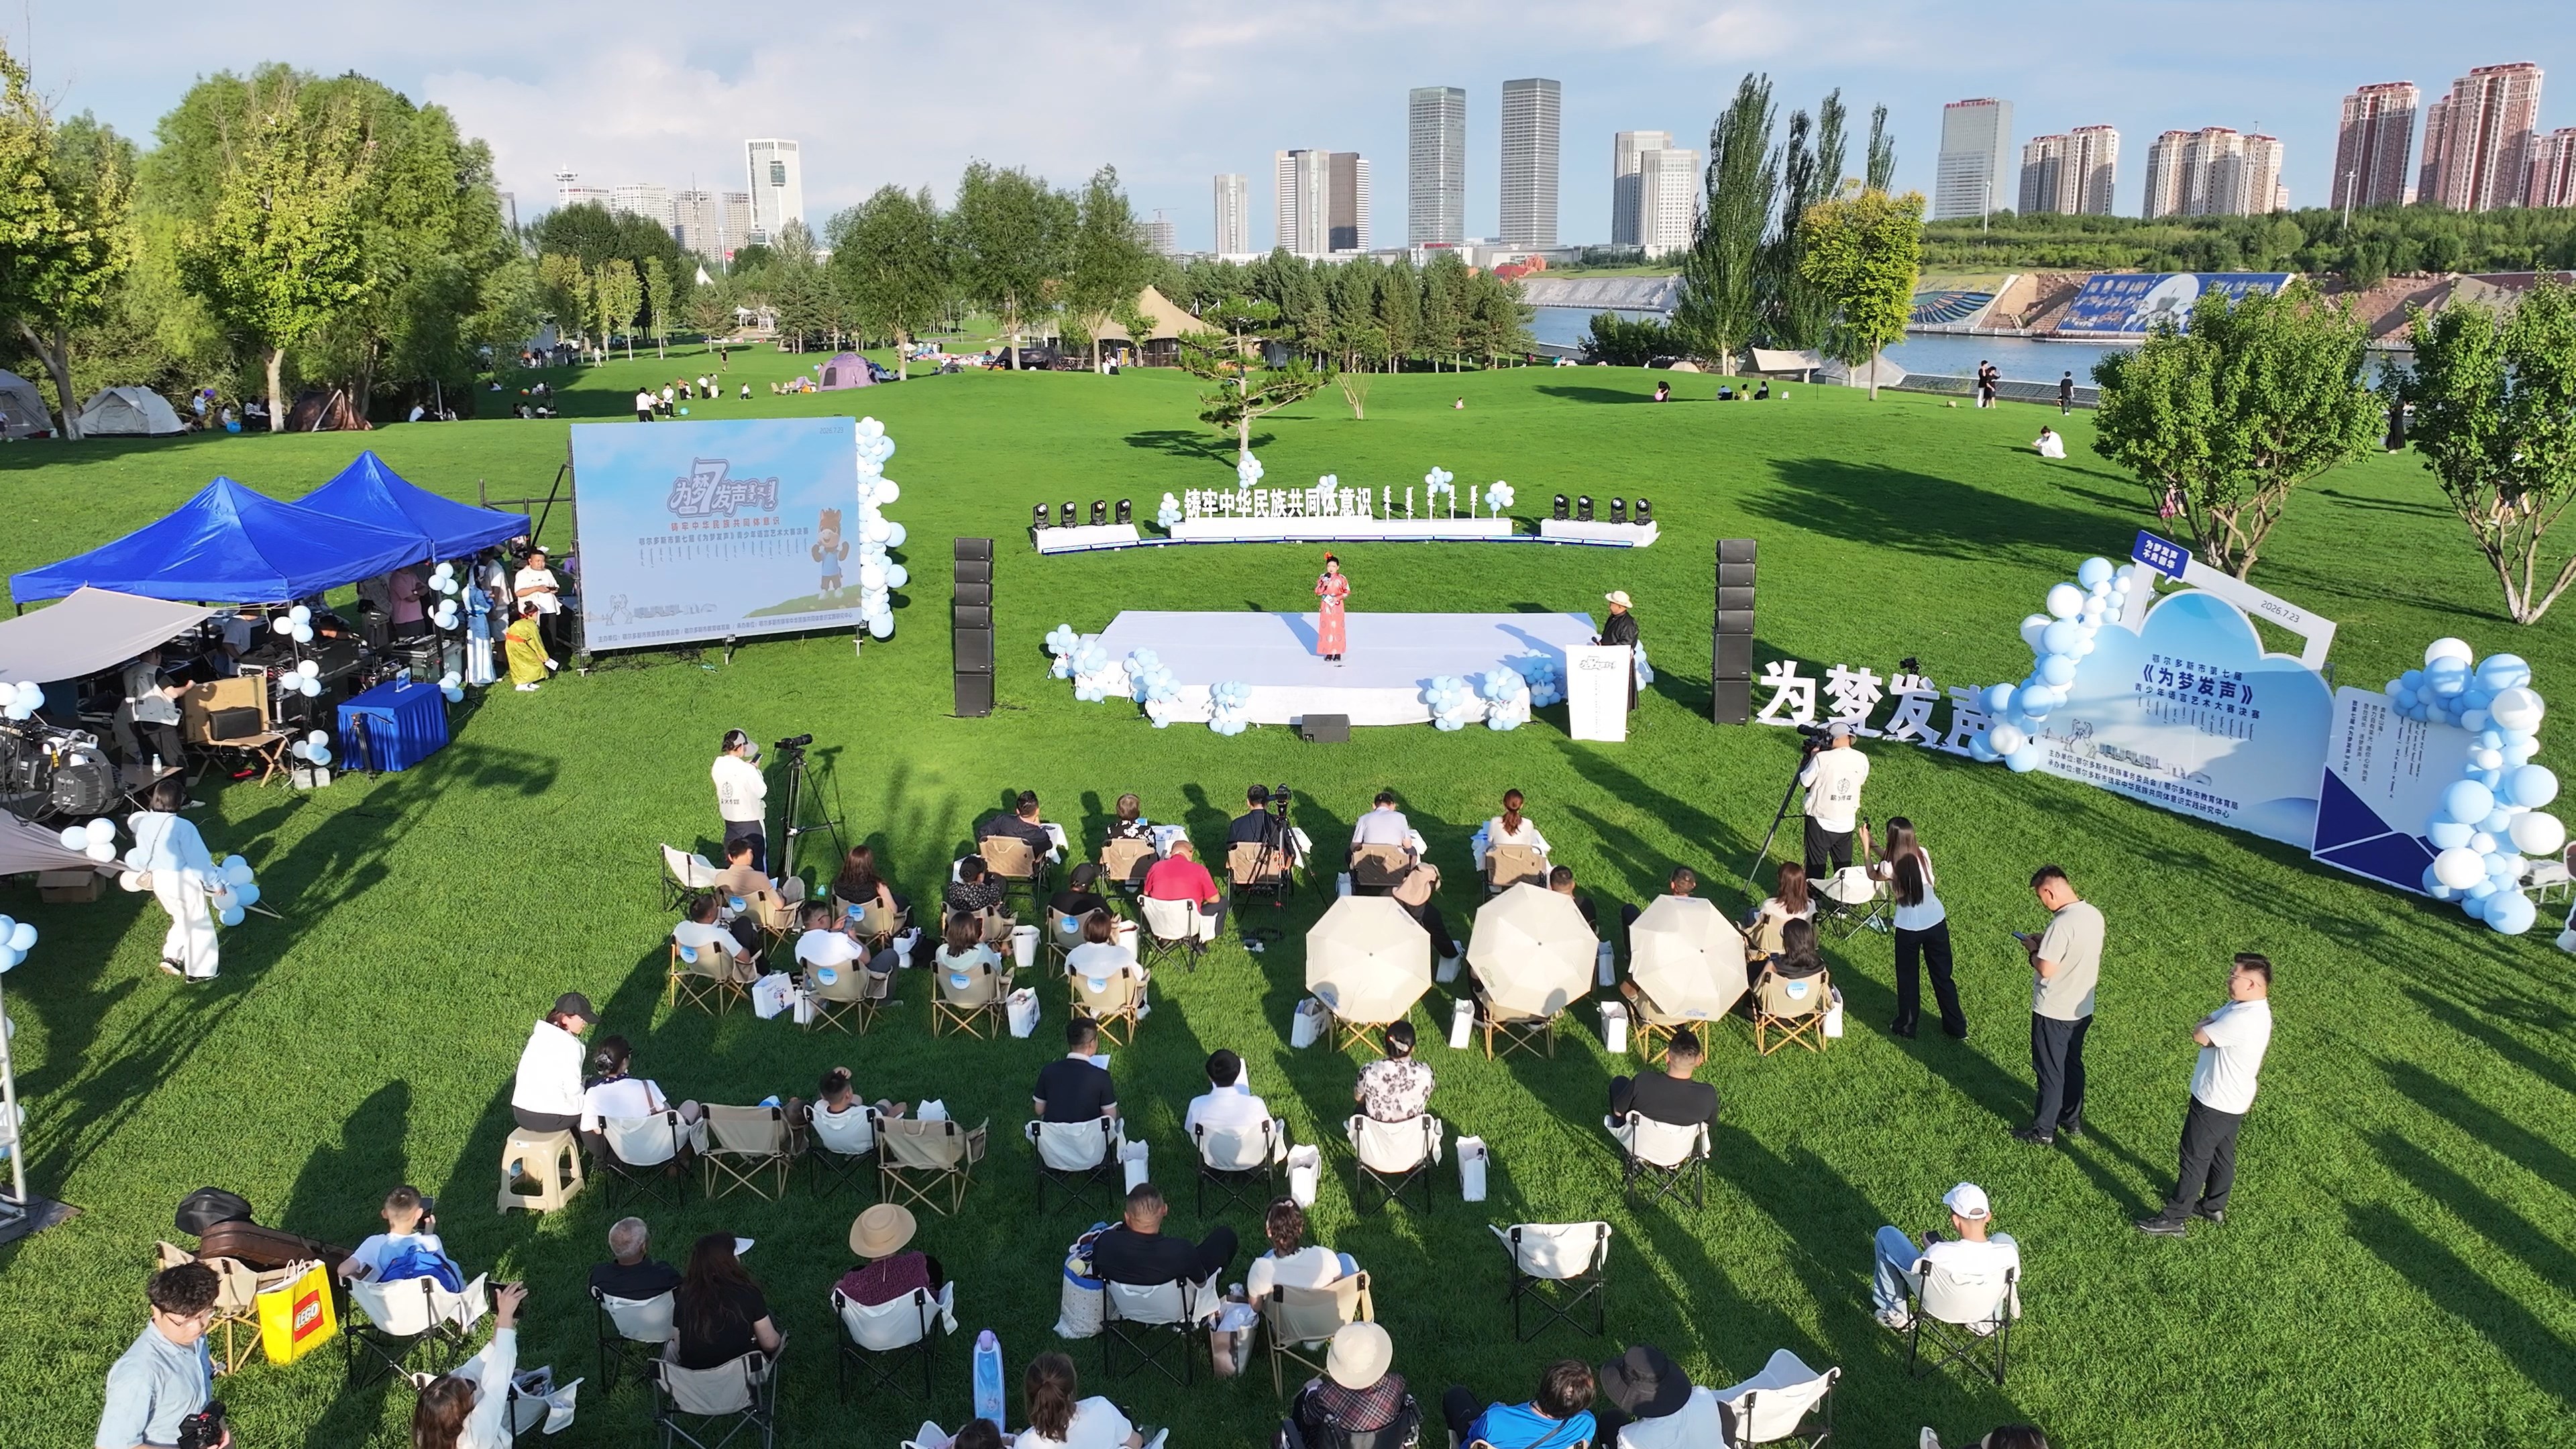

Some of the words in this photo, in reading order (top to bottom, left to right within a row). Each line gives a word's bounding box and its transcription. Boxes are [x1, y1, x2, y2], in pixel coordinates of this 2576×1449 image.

[1183, 486, 1373, 518] 铸牢中华民族共同体意识
[671, 517, 780, 531] 铸牢中华民族共同体意识
[2145, 539, 2179, 559] 为梦发声
[2261, 600, 2300, 623] 2026.7.23
[2152, 654, 2243, 681] 鄂尔多斯市第七届
[2143, 664, 2253, 704] 《为梦发声》
[1757, 659, 1995, 749] 为梦发声
[2135, 683, 2260, 720] 青少年语言艺术大赛决赛
[295, 1301, 319, 1330] LEGO
